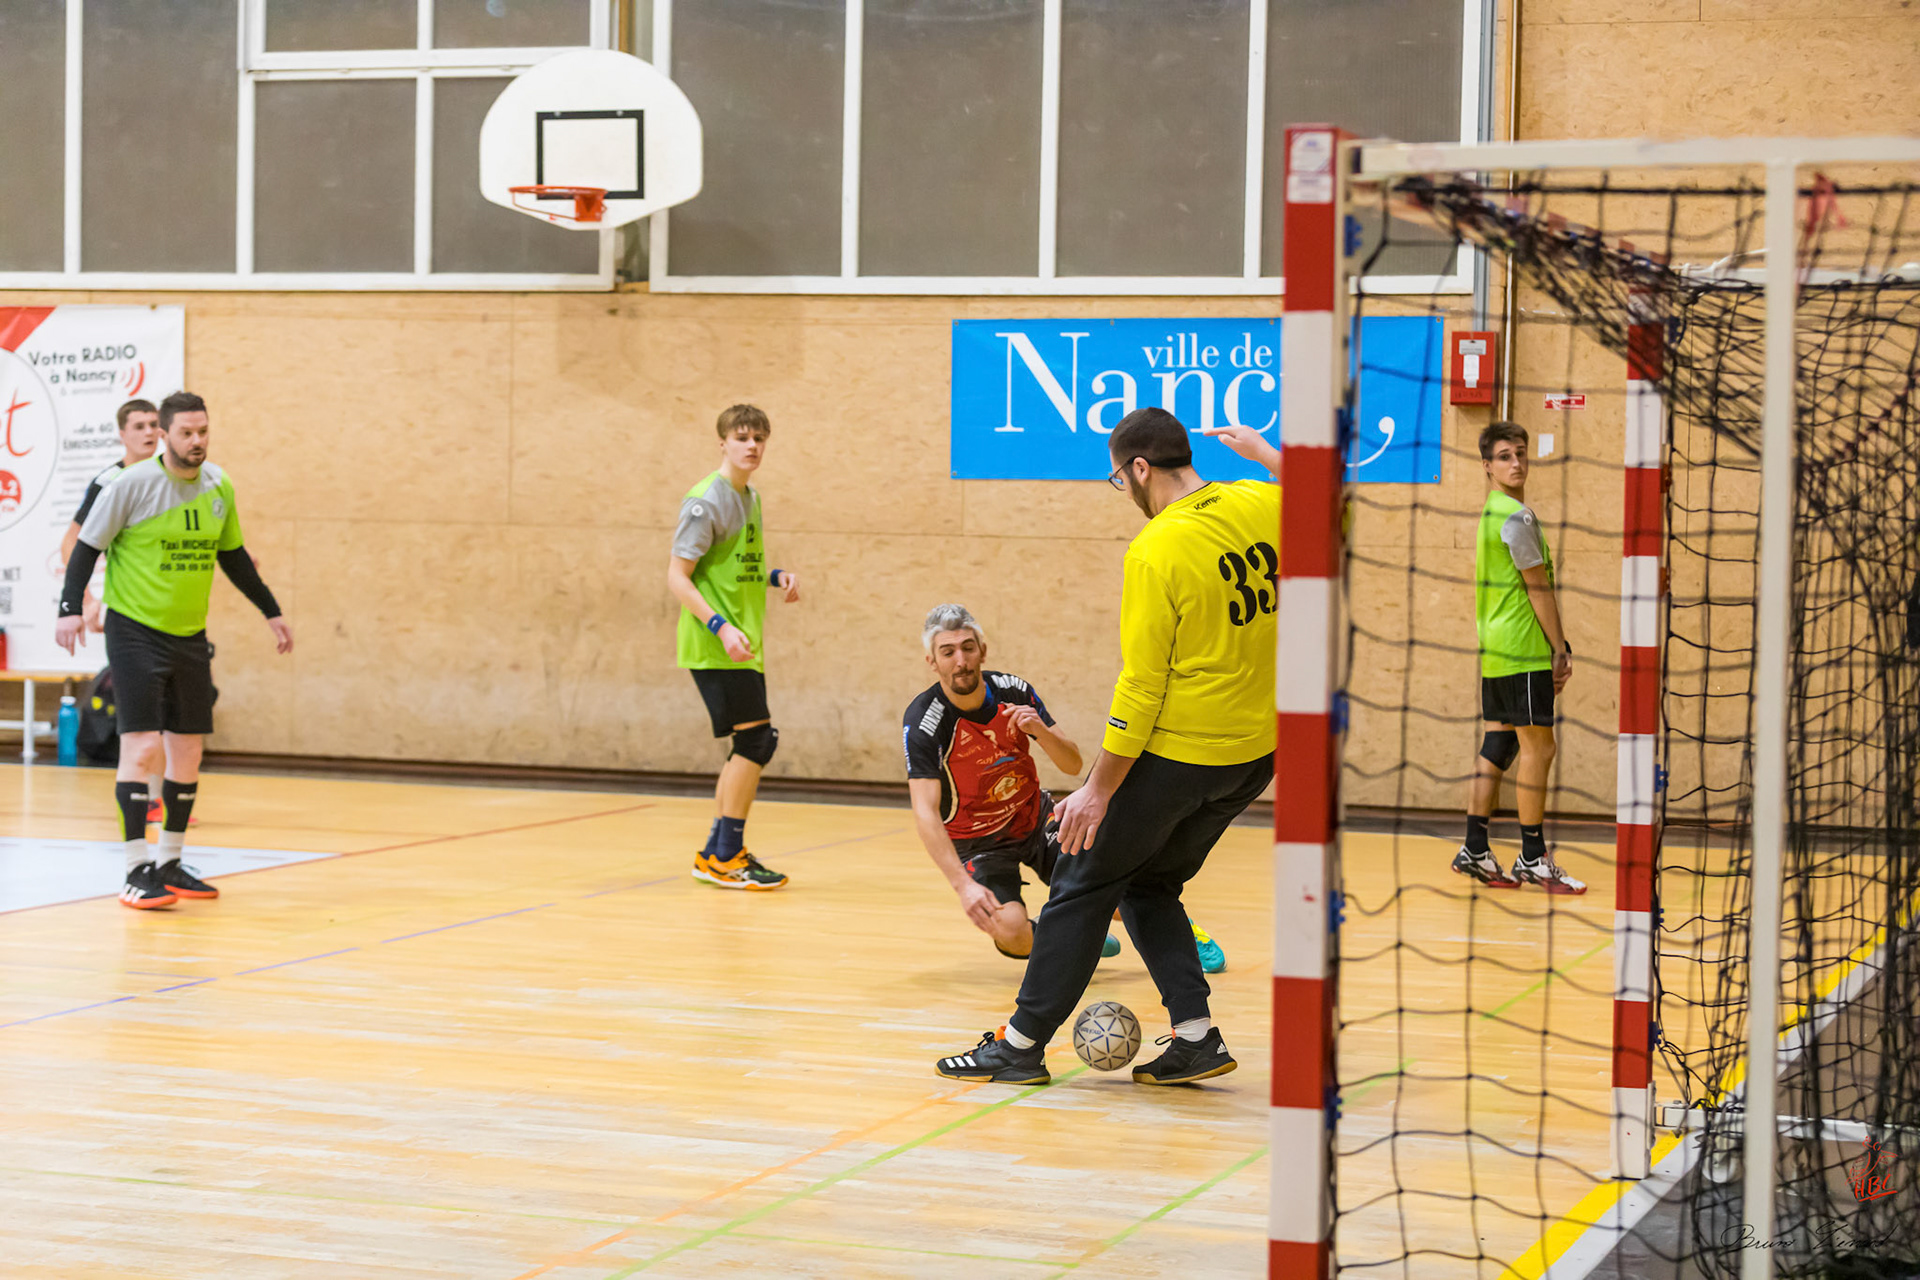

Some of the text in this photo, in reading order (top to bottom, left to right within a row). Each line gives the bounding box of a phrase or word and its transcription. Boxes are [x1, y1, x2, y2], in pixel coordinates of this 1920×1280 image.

[28, 344, 137, 366] Votre RADIO
[1142, 333, 1273, 369] ville de
[66, 368, 117, 385] Nancy
[184, 509, 200, 531] 11
[1218, 541, 1278, 627] 33
